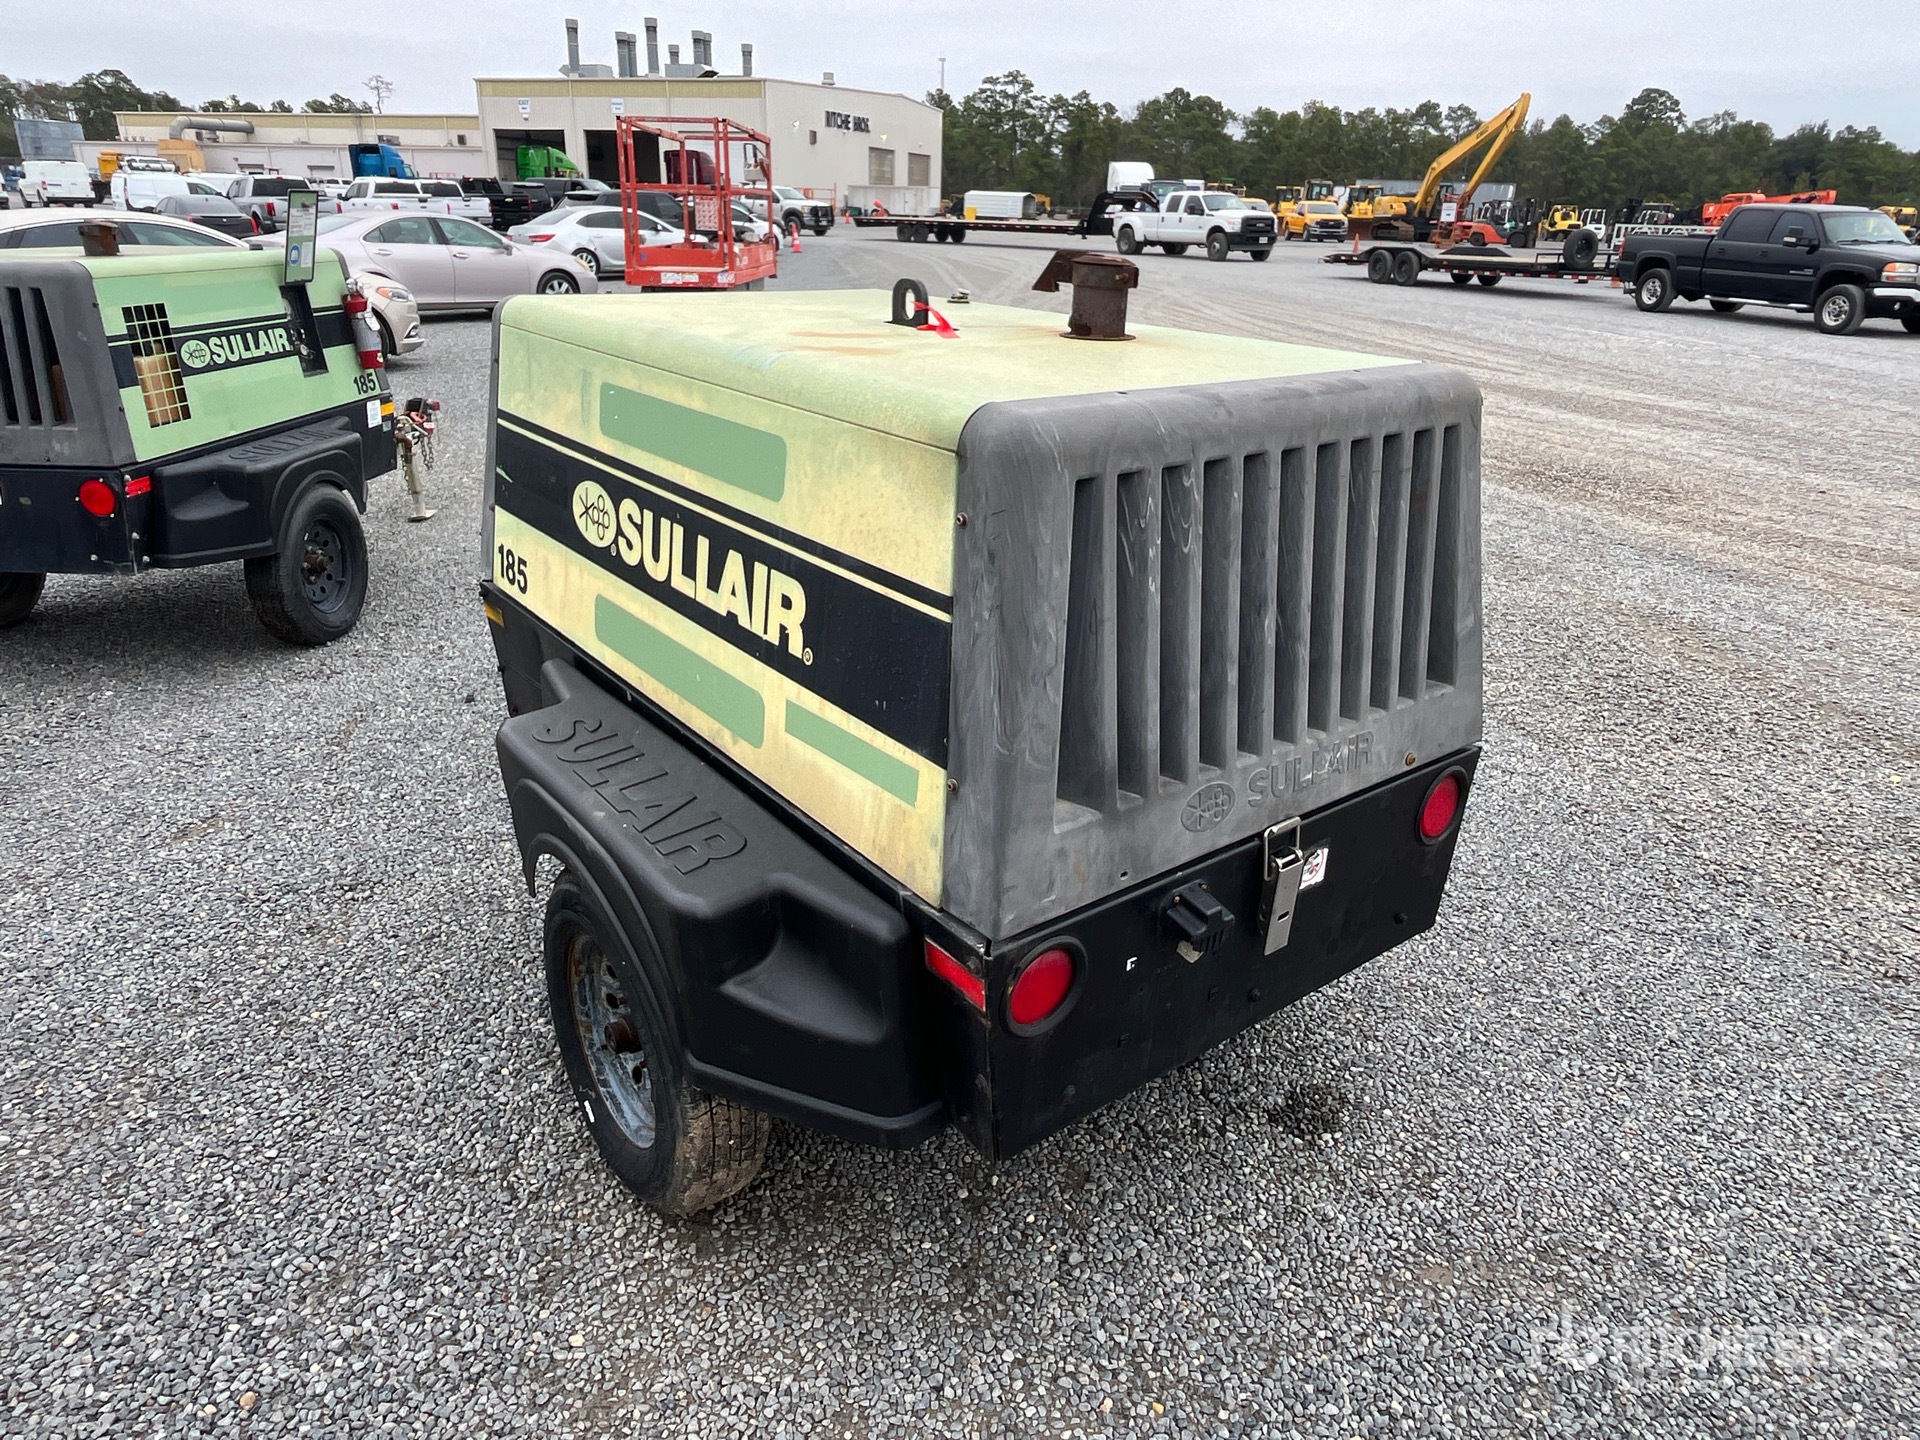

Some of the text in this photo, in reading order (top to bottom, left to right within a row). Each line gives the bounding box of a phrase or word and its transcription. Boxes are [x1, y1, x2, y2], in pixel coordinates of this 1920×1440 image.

[208, 327, 291, 365] SULLAIR
[353, 372, 377, 395] 185
[497, 542, 528, 595] 185
[618, 497, 806, 660] SULLAIR
[531, 719, 747, 876] SULLAIR
[1247, 730, 1374, 808] SULLAIR
